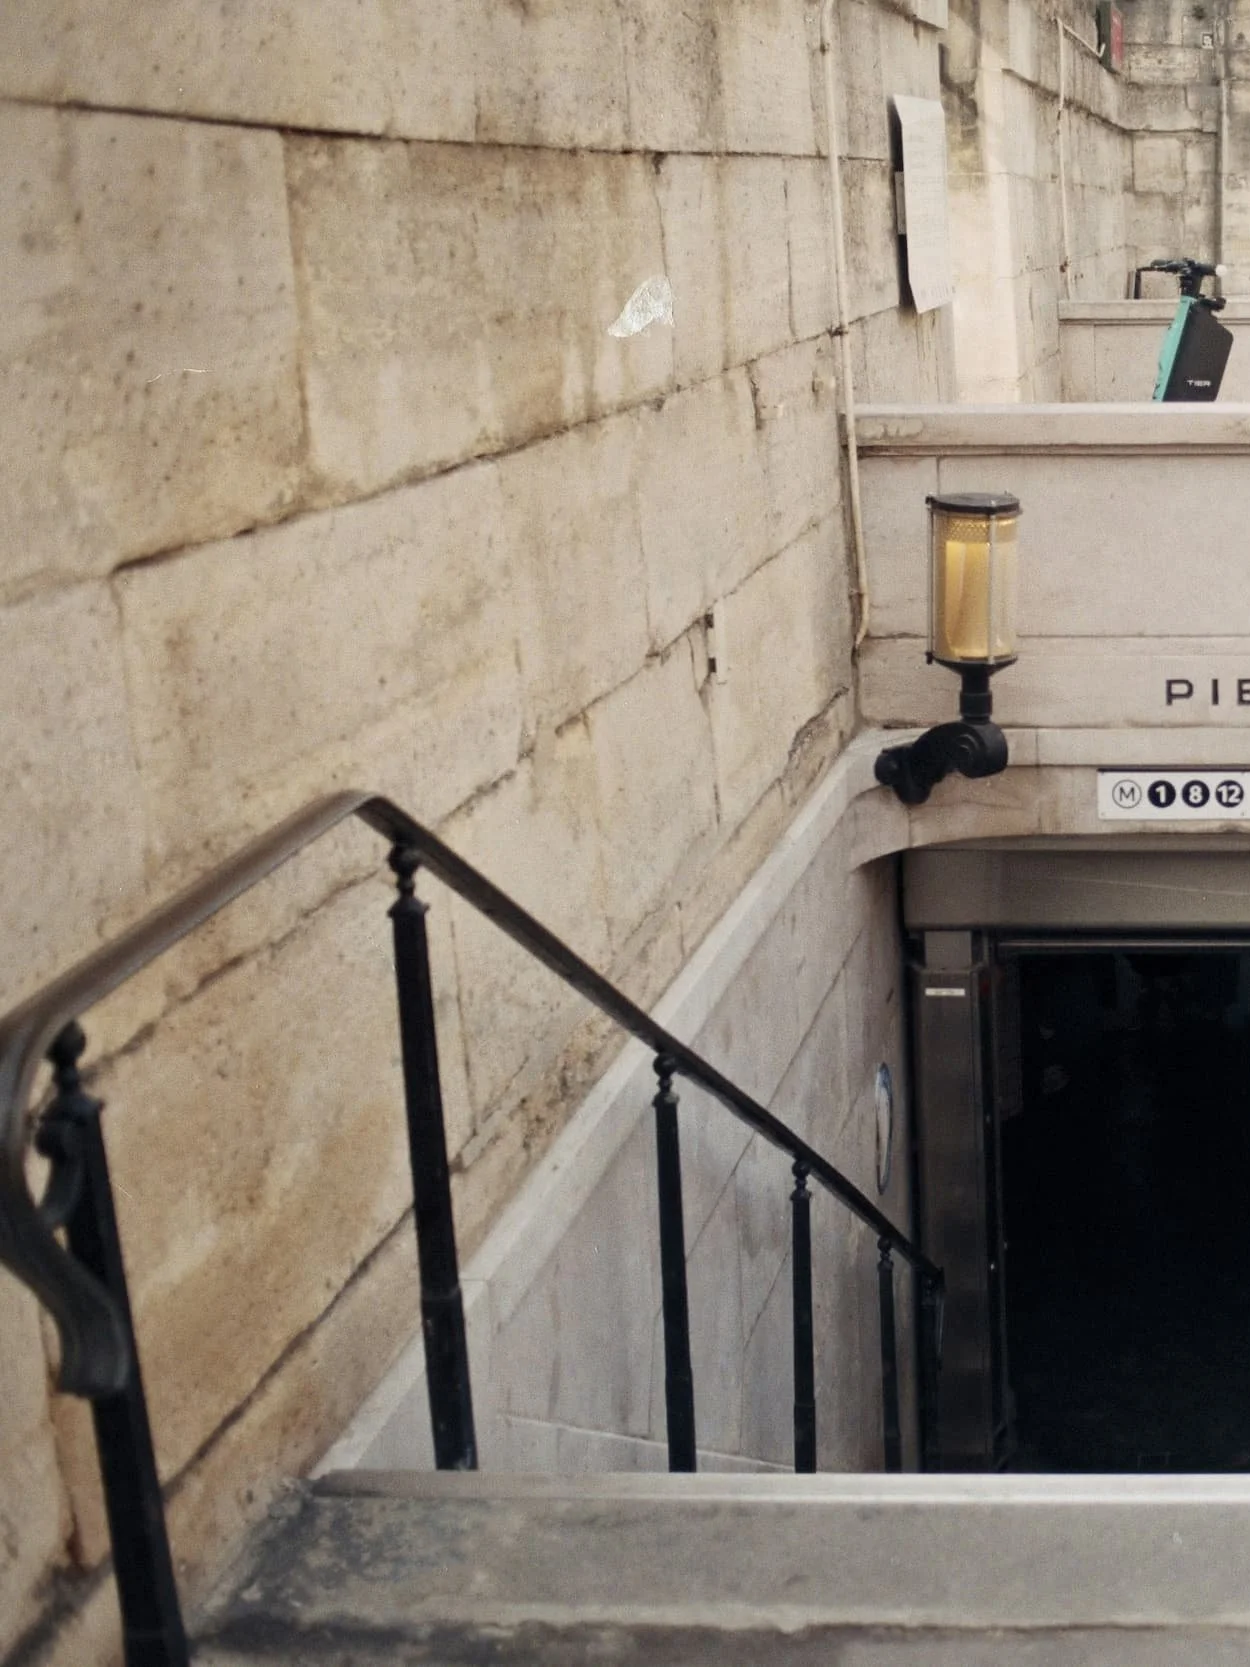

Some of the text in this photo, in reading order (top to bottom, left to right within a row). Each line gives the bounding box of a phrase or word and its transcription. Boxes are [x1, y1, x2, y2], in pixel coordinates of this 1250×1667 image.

[1155, 784, 1167, 805] 1
[1188, 784, 1204, 805] 8
[1217, 784, 1242, 805] 12
